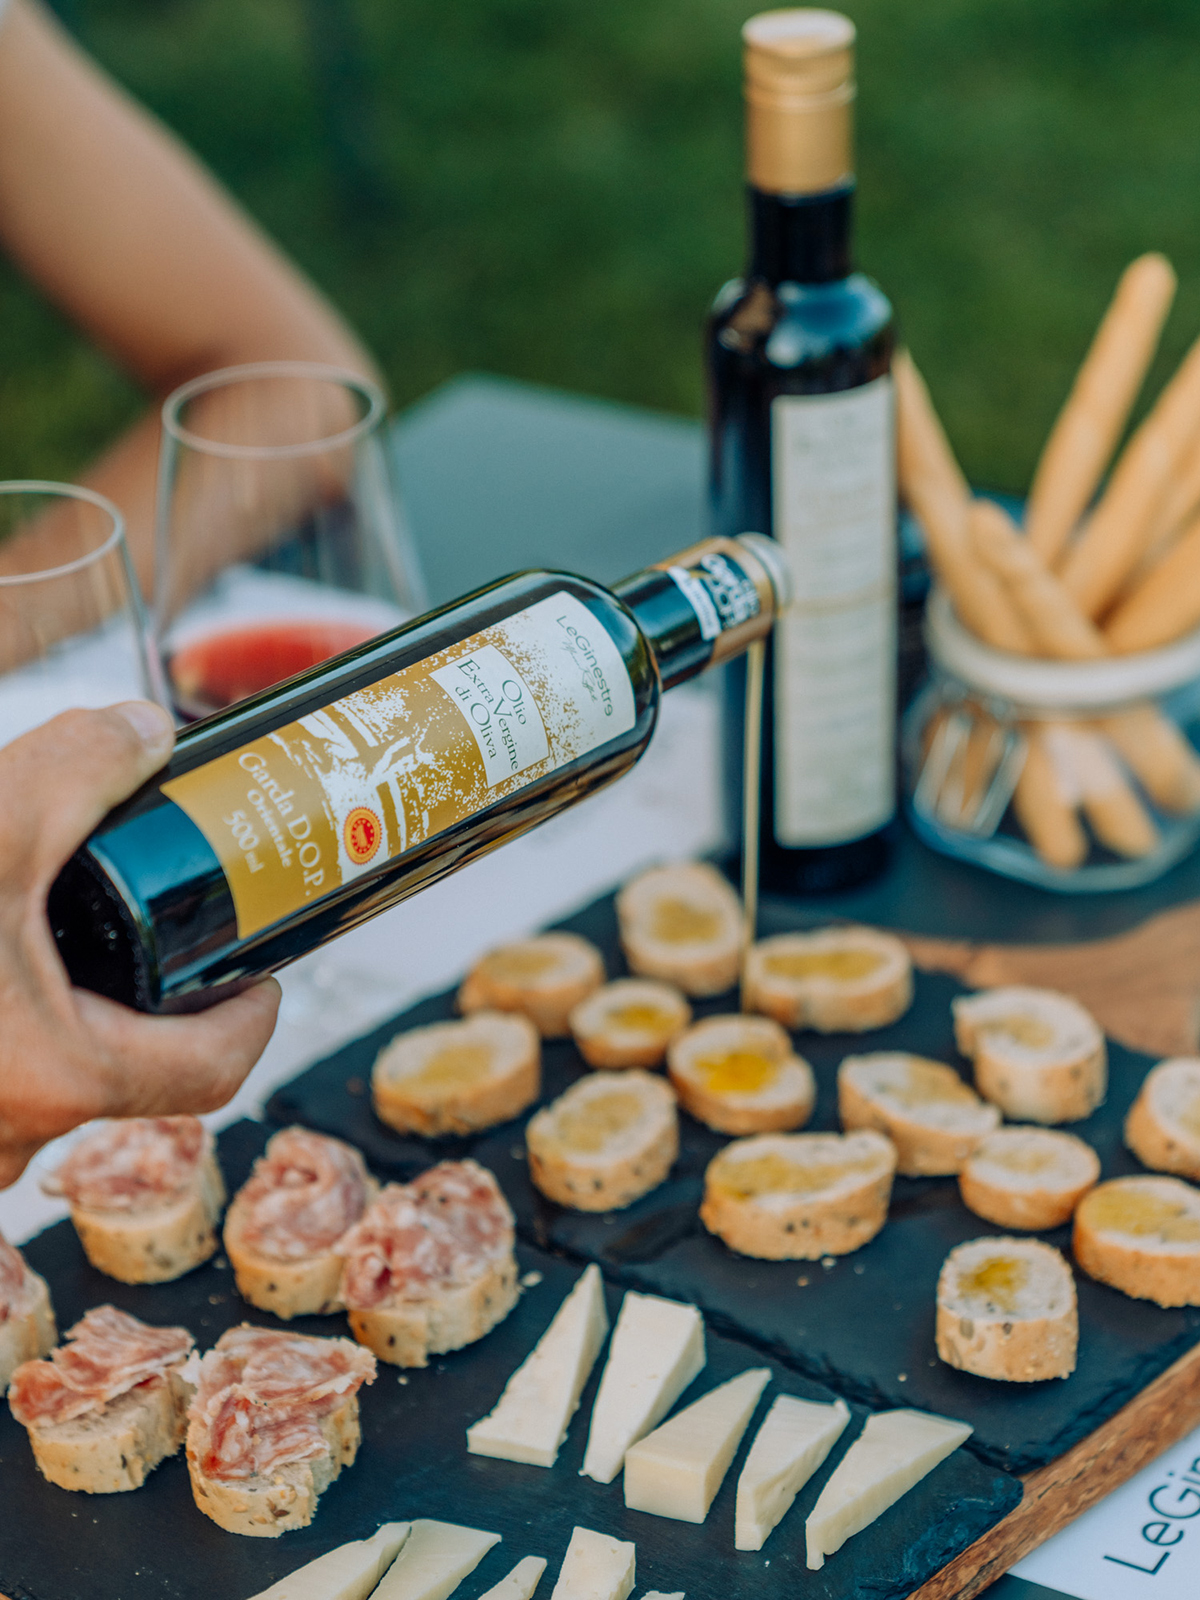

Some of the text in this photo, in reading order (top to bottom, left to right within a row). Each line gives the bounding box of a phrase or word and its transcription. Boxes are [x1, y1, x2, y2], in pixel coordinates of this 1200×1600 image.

[455, 686, 497, 759] di Oliva
[456, 658, 519, 771] Extra Vergine
[502, 679, 527, 725] Olio
[222, 809, 265, 874] 500 ml
[238, 752, 325, 896] Garda D.O.P.
[247, 789, 293, 868] Orientale
